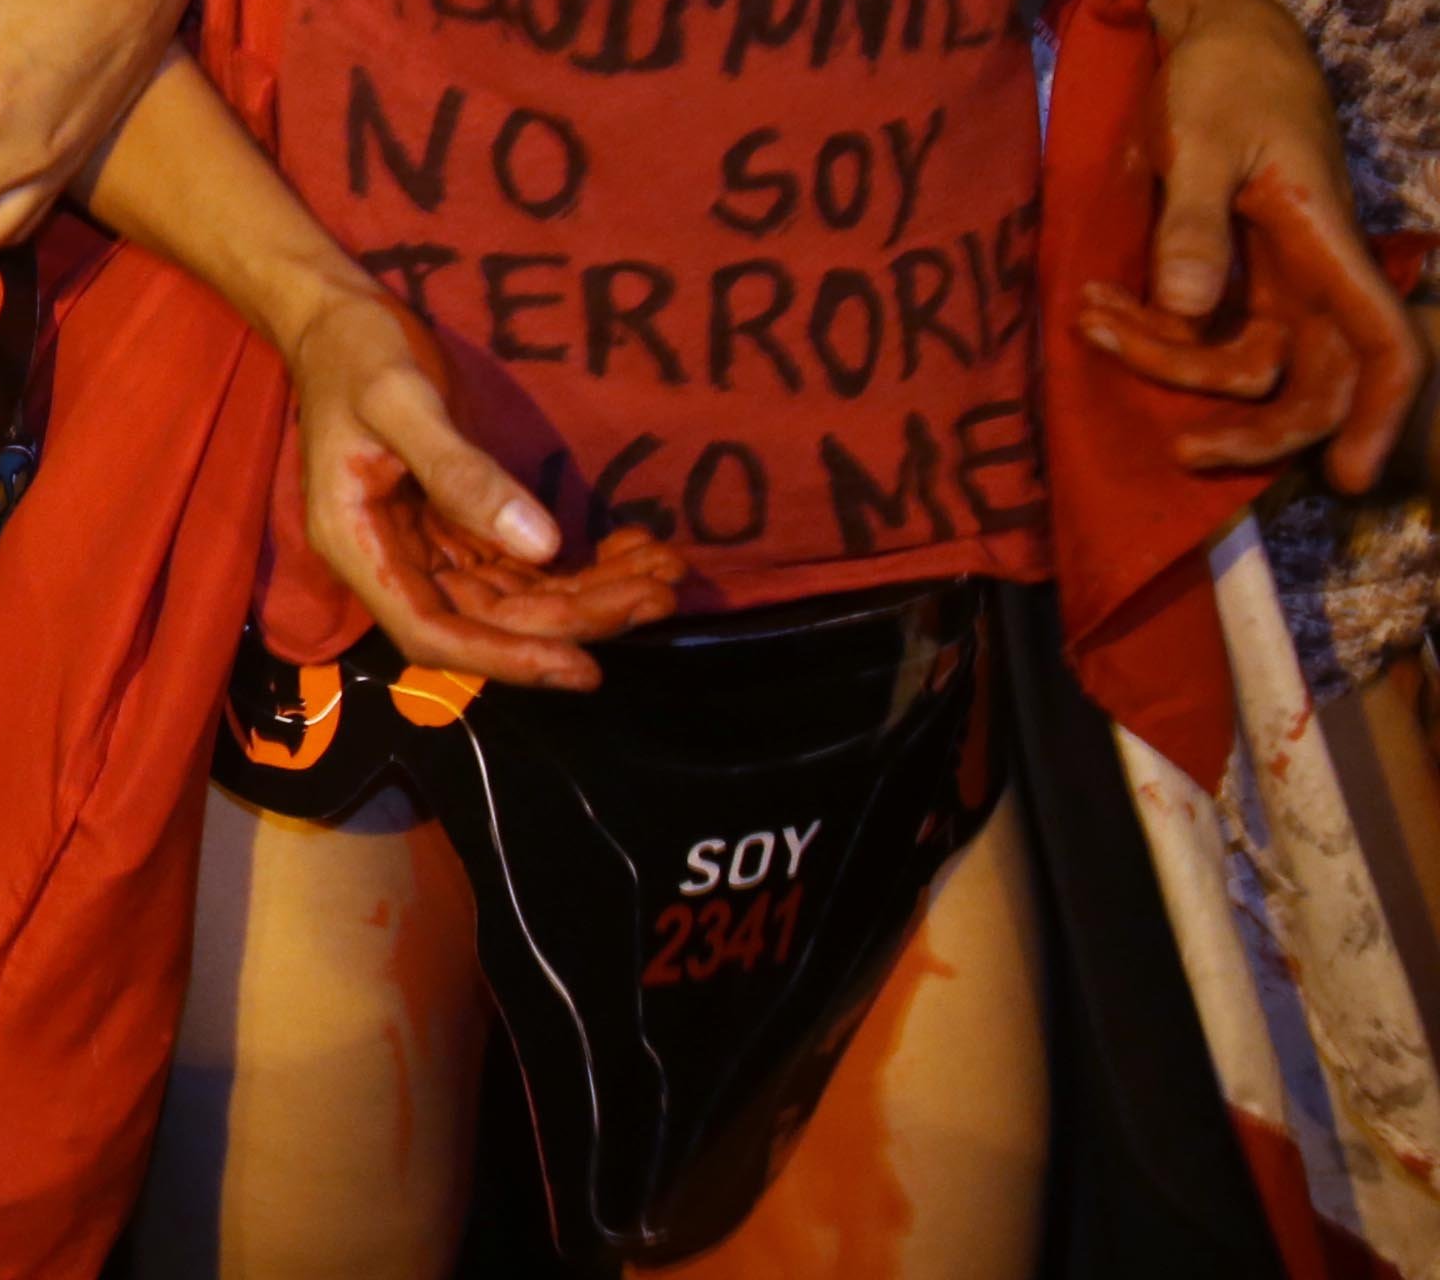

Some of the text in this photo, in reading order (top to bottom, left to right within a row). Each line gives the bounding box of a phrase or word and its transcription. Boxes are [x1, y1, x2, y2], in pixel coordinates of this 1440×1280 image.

[348, 65, 945, 248] NO SOY
[678, 818, 823, 898] SOY
[641, 883, 805, 989] 2341
